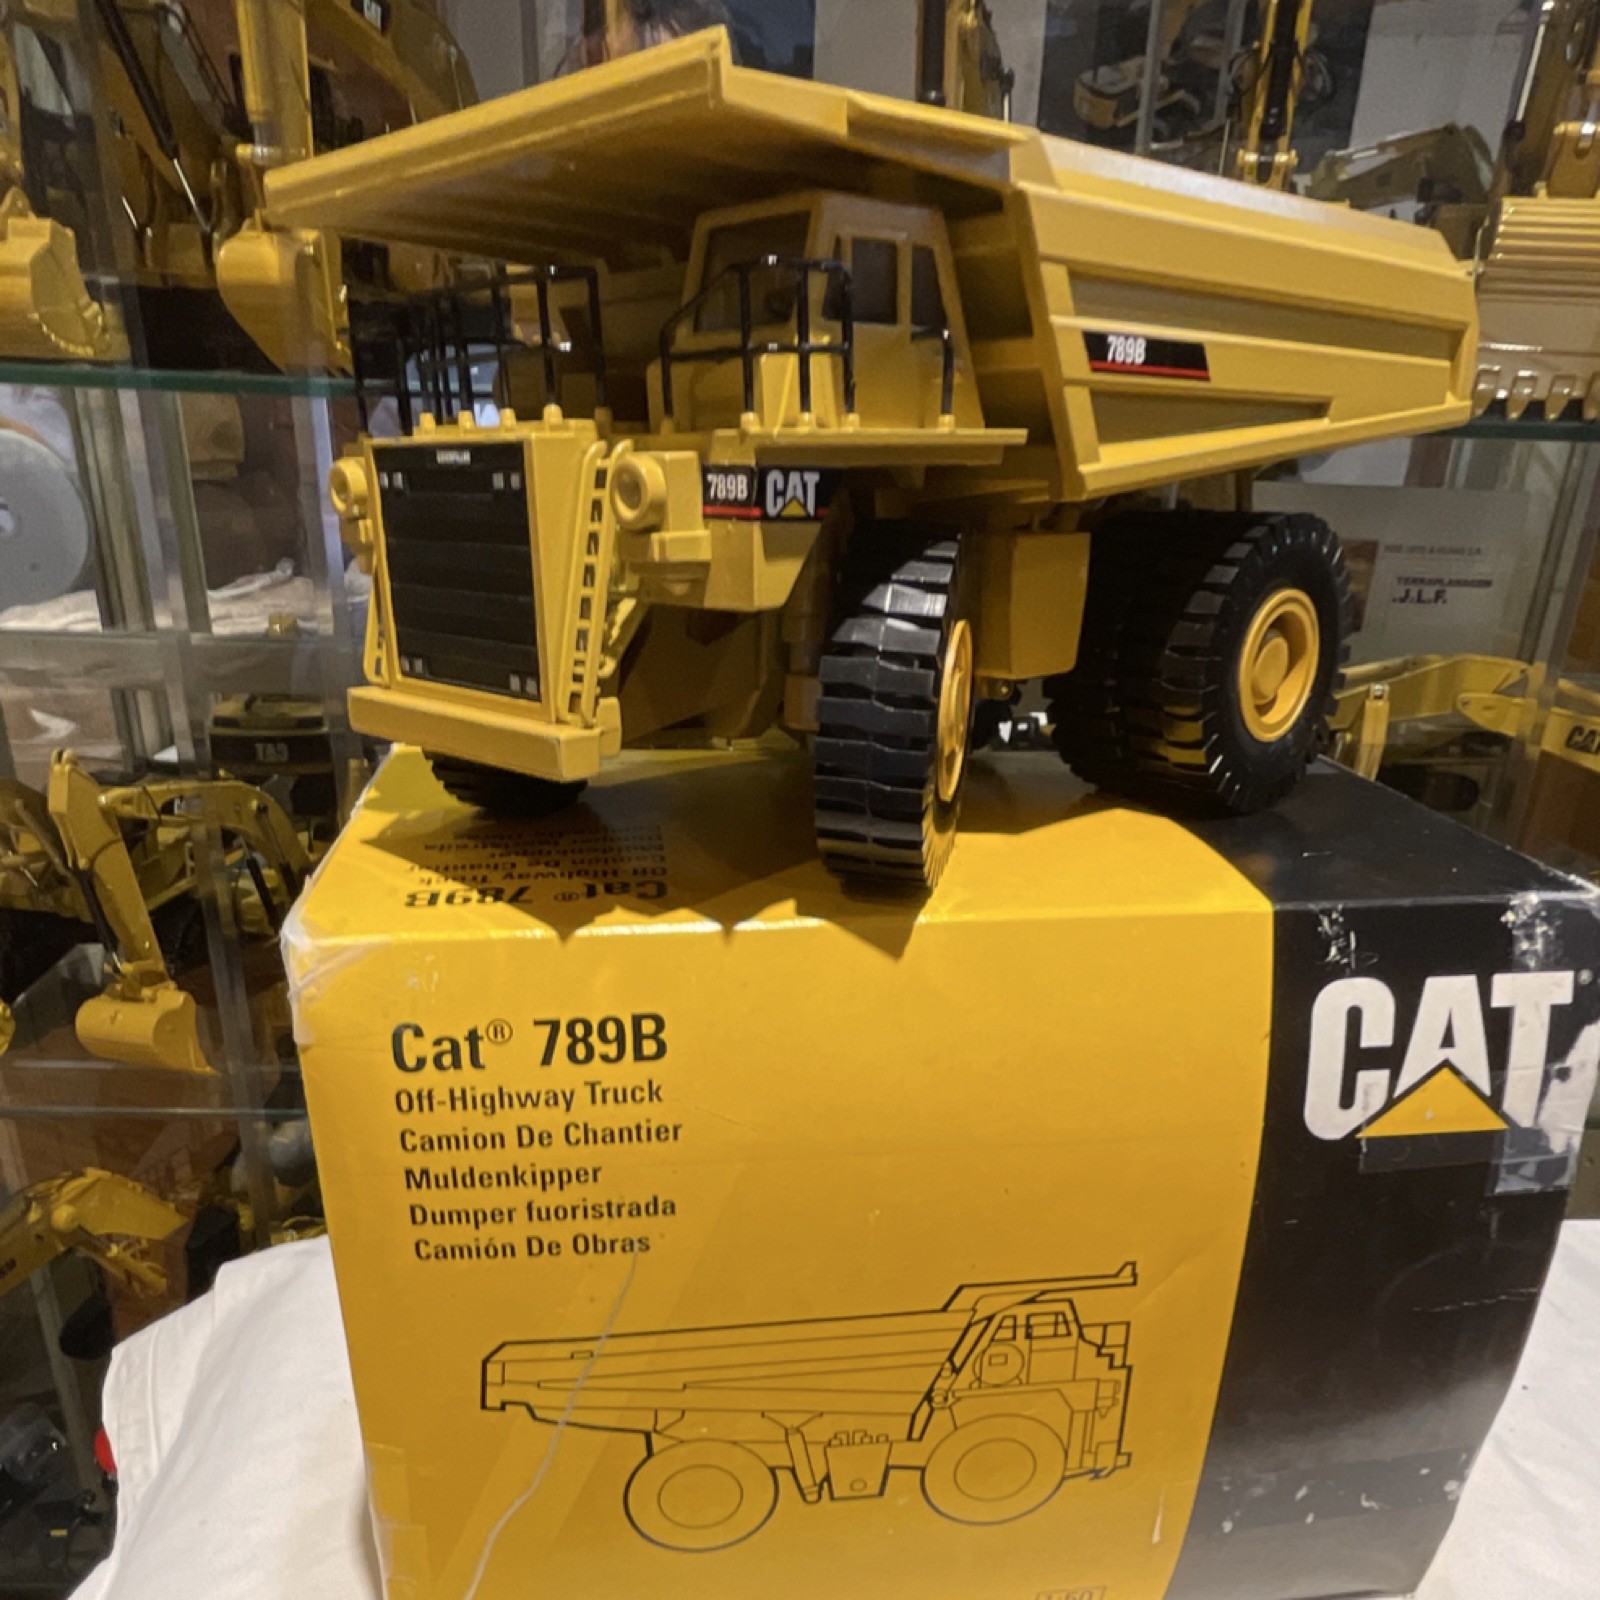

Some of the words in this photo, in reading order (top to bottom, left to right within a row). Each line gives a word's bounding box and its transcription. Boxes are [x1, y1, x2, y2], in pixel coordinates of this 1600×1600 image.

[1107, 334, 1147, 365] 789B
[706, 472, 748, 501] 789B
[765, 469, 821, 517] CAT
[1566, 725, 1600, 756] CA
[533, 1012, 667, 1067] 789B
[395, 1085, 575, 1116] Off-Highway
[584, 1080, 663, 1105] Truck
[400, 1127, 506, 1152] Camion
[516, 1124, 553, 1149] De
[564, 1119, 683, 1146] Chantier
[404, 1163, 602, 1192] Muldenkipper
[409, 1203, 516, 1230] Dumper
[526, 1195, 677, 1222] fuoristrada
[414, 1238, 517, 1261] Camión
[526, 1236, 561, 1257] De
[572, 1233, 651, 1255] Obras
